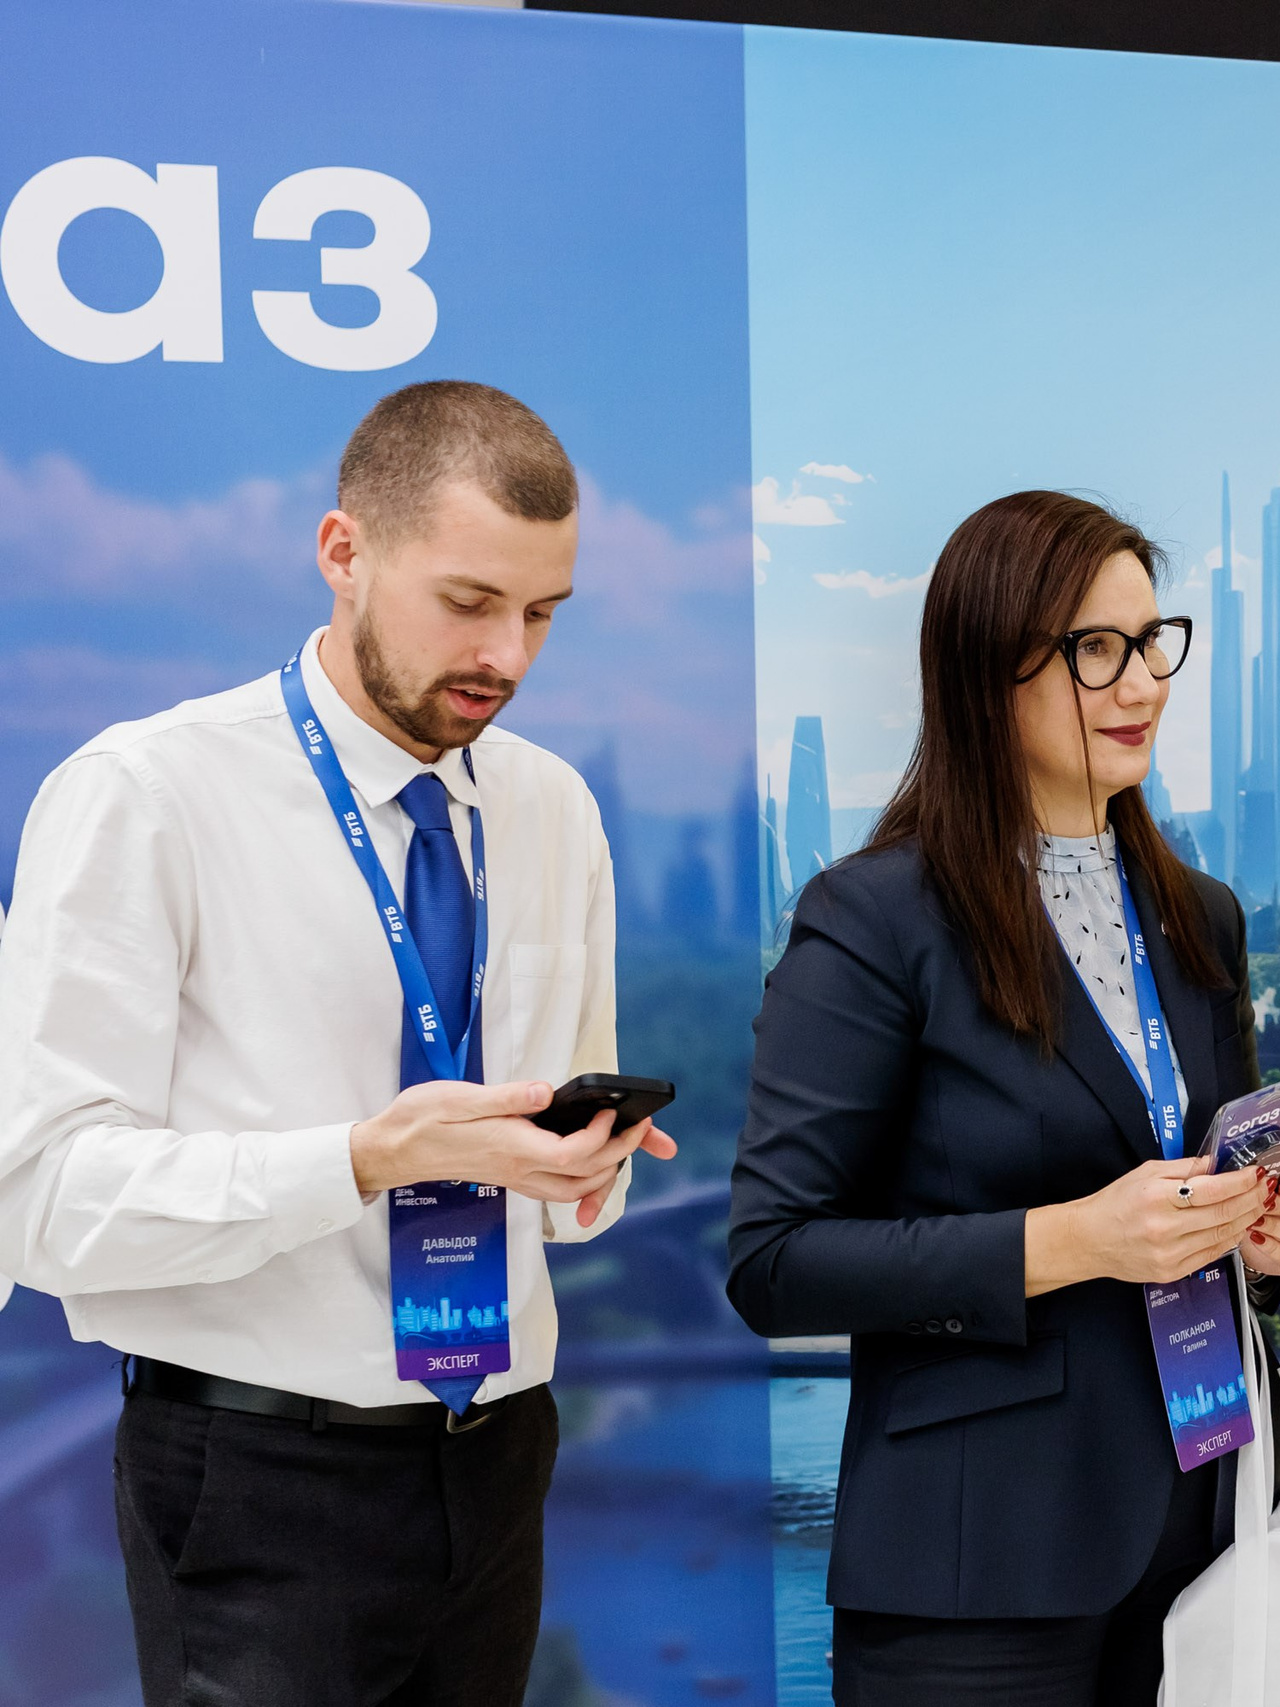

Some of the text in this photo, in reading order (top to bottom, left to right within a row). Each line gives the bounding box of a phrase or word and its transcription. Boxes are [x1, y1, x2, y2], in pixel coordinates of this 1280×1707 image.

[301, 719, 323, 745] ВТБ
[343, 811, 364, 836] ВТБ
[383, 905, 404, 931] ВТБ
[1134, 933, 1145, 955] ВТБ
[417, 1003, 437, 1031] ВТБ
[1147, 1017, 1162, 1041] ВТБ
[1162, 1104, 1177, 1129] ВТБ
[1227, 1107, 1280, 1138] согаз
[394, 1188, 415, 1198] ДЕНЬ
[395, 1197, 437, 1206] ИНВЕСТОРА
[477, 1185, 499, 1198] ВТБ
[422, 1236, 477, 1251] ДАВЫДОВ
[425, 1252, 475, 1264] Анатолий
[1205, 1268, 1221, 1283] ВТБ
[1149, 1289, 1163, 1300] ДЕНЬ
[1151, 1292, 1180, 1308] ИНВЕСТОРА
[1169, 1318, 1217, 1345] ПОЛКАНОВА
[1182, 1337, 1208, 1354] Галина
[427, 1353, 480, 1371] ЭКСПЕРТ
[1196, 1430, 1232, 1457] ЭКСПЕРТ
